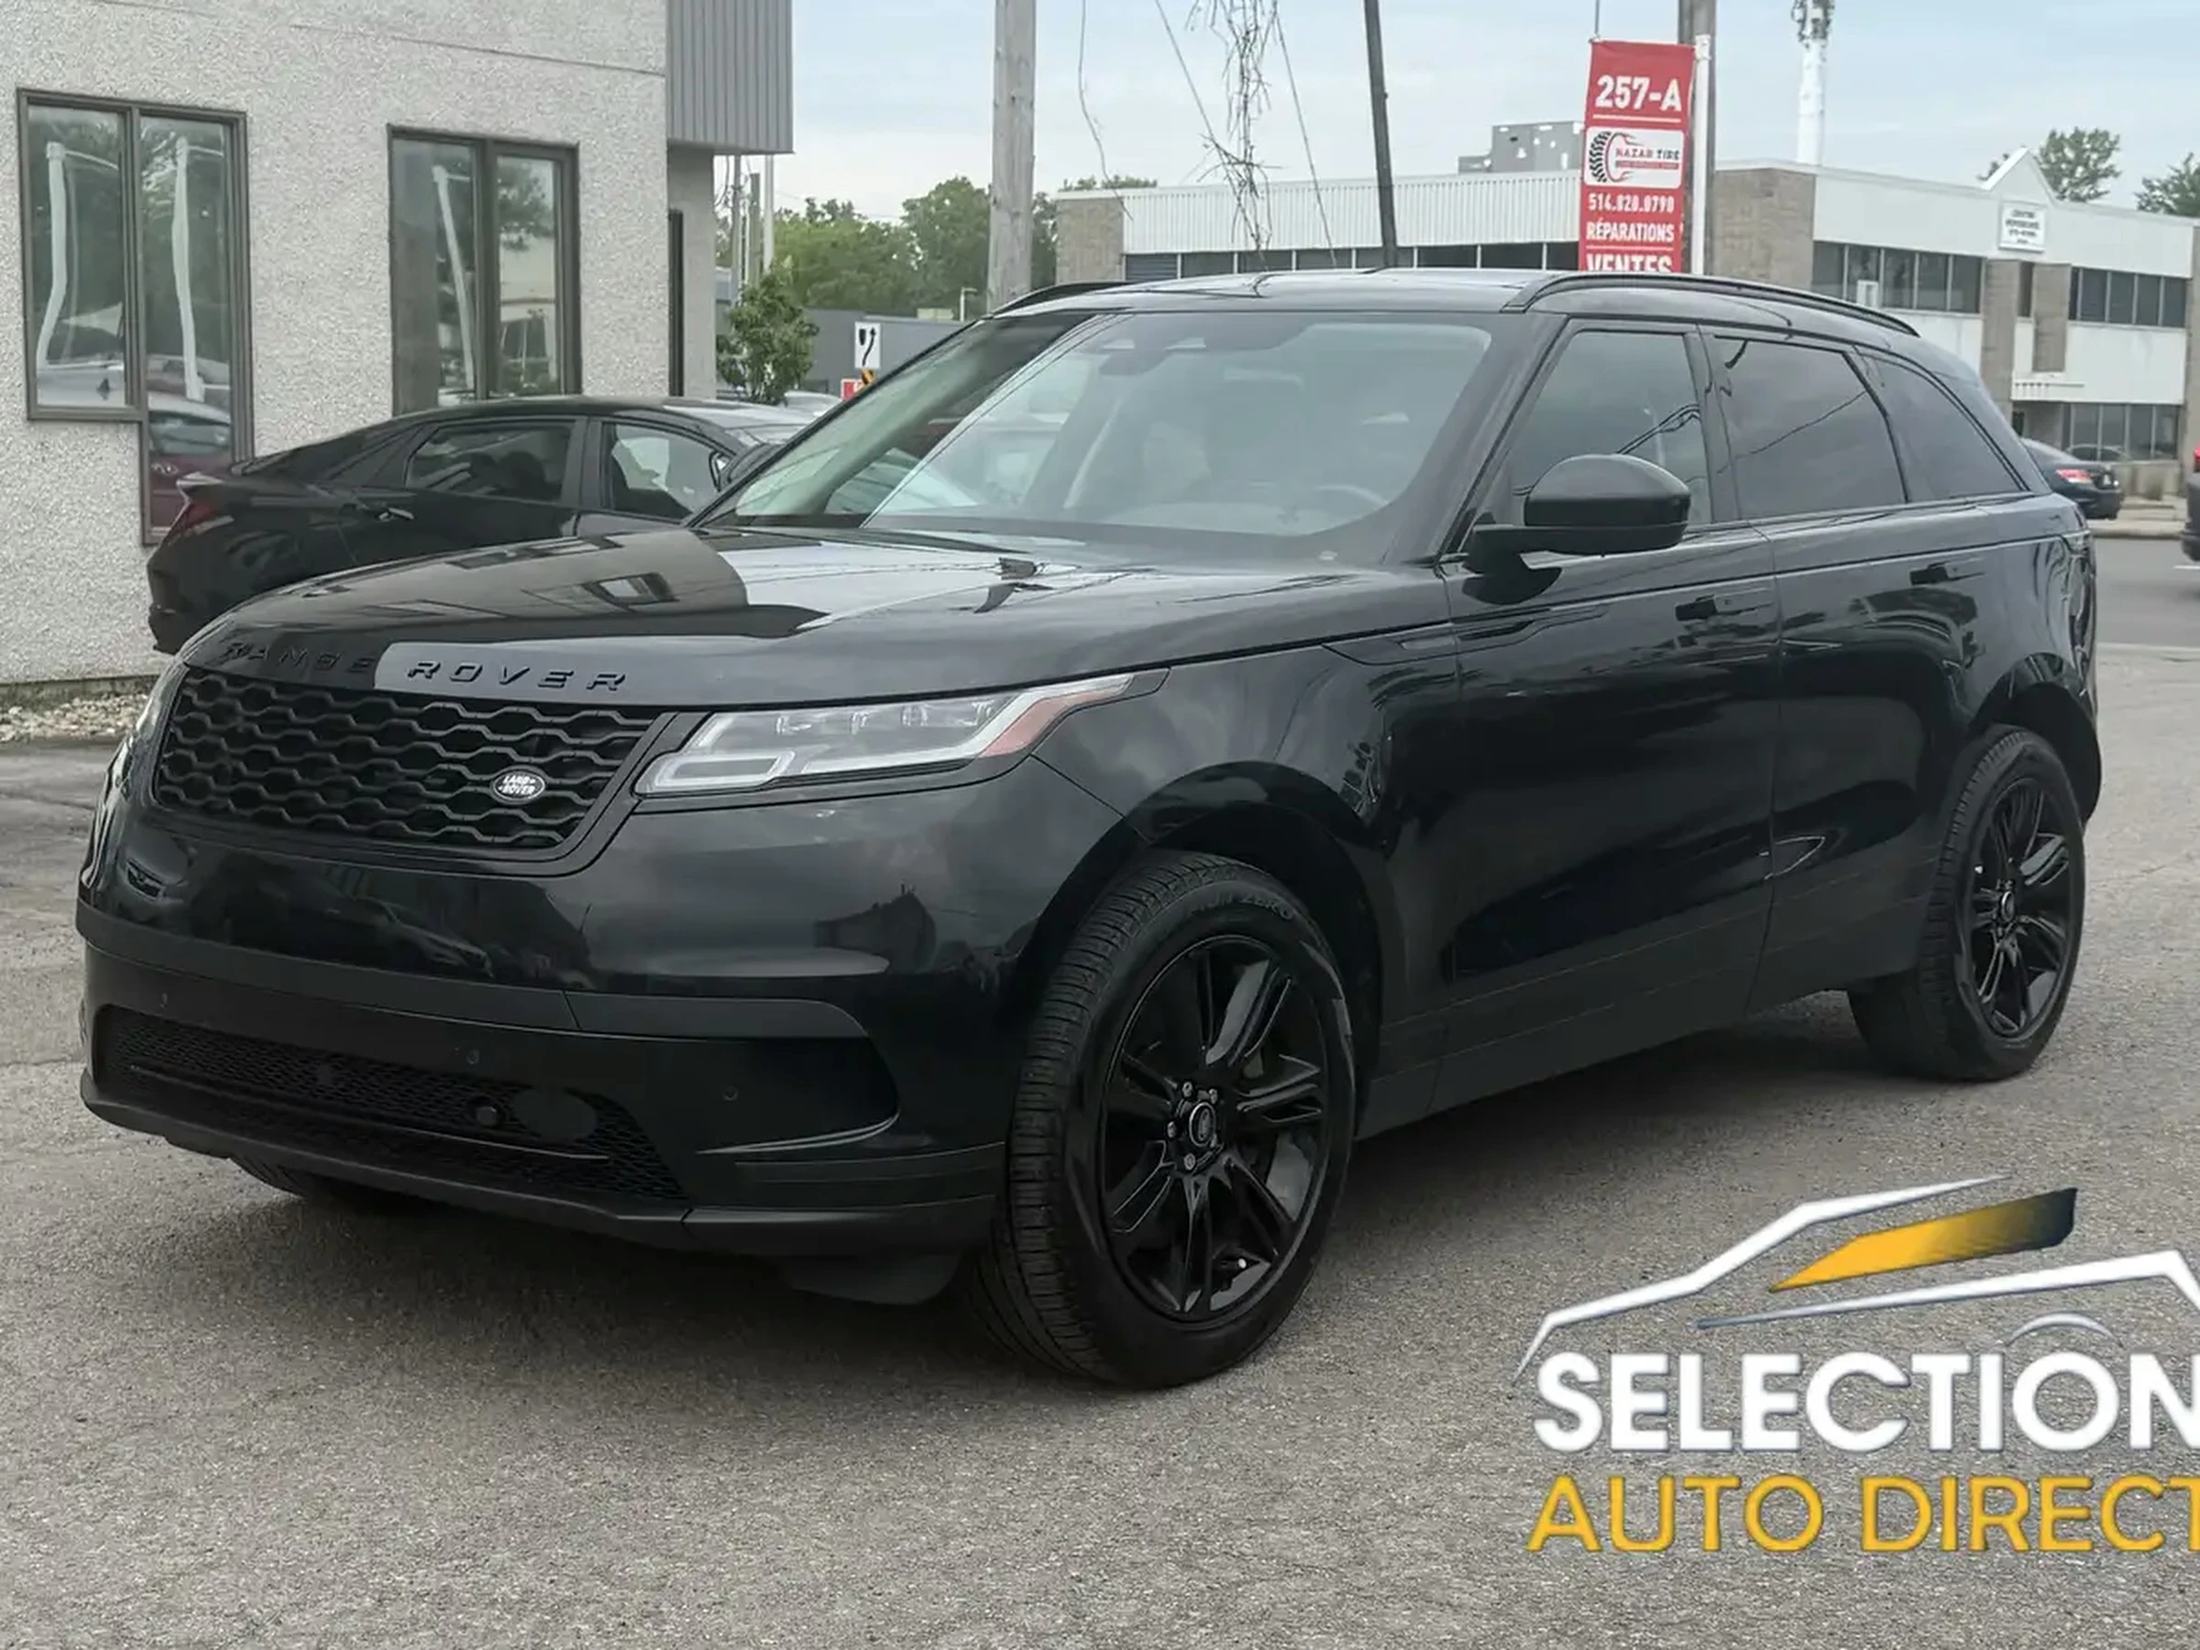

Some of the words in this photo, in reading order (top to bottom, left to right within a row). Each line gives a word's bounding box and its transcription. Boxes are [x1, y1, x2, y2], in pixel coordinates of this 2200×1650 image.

[1595, 74, 1682, 112] 257-A
[1586, 217, 1675, 242] RÉPARATIONS
[1586, 253, 1673, 272] VENTES
[220, 641, 376, 673] RANGE
[407, 660, 626, 691] ROVER
[501, 785, 536, 795] ROVER
[502, 775, 531, 784] LAND
